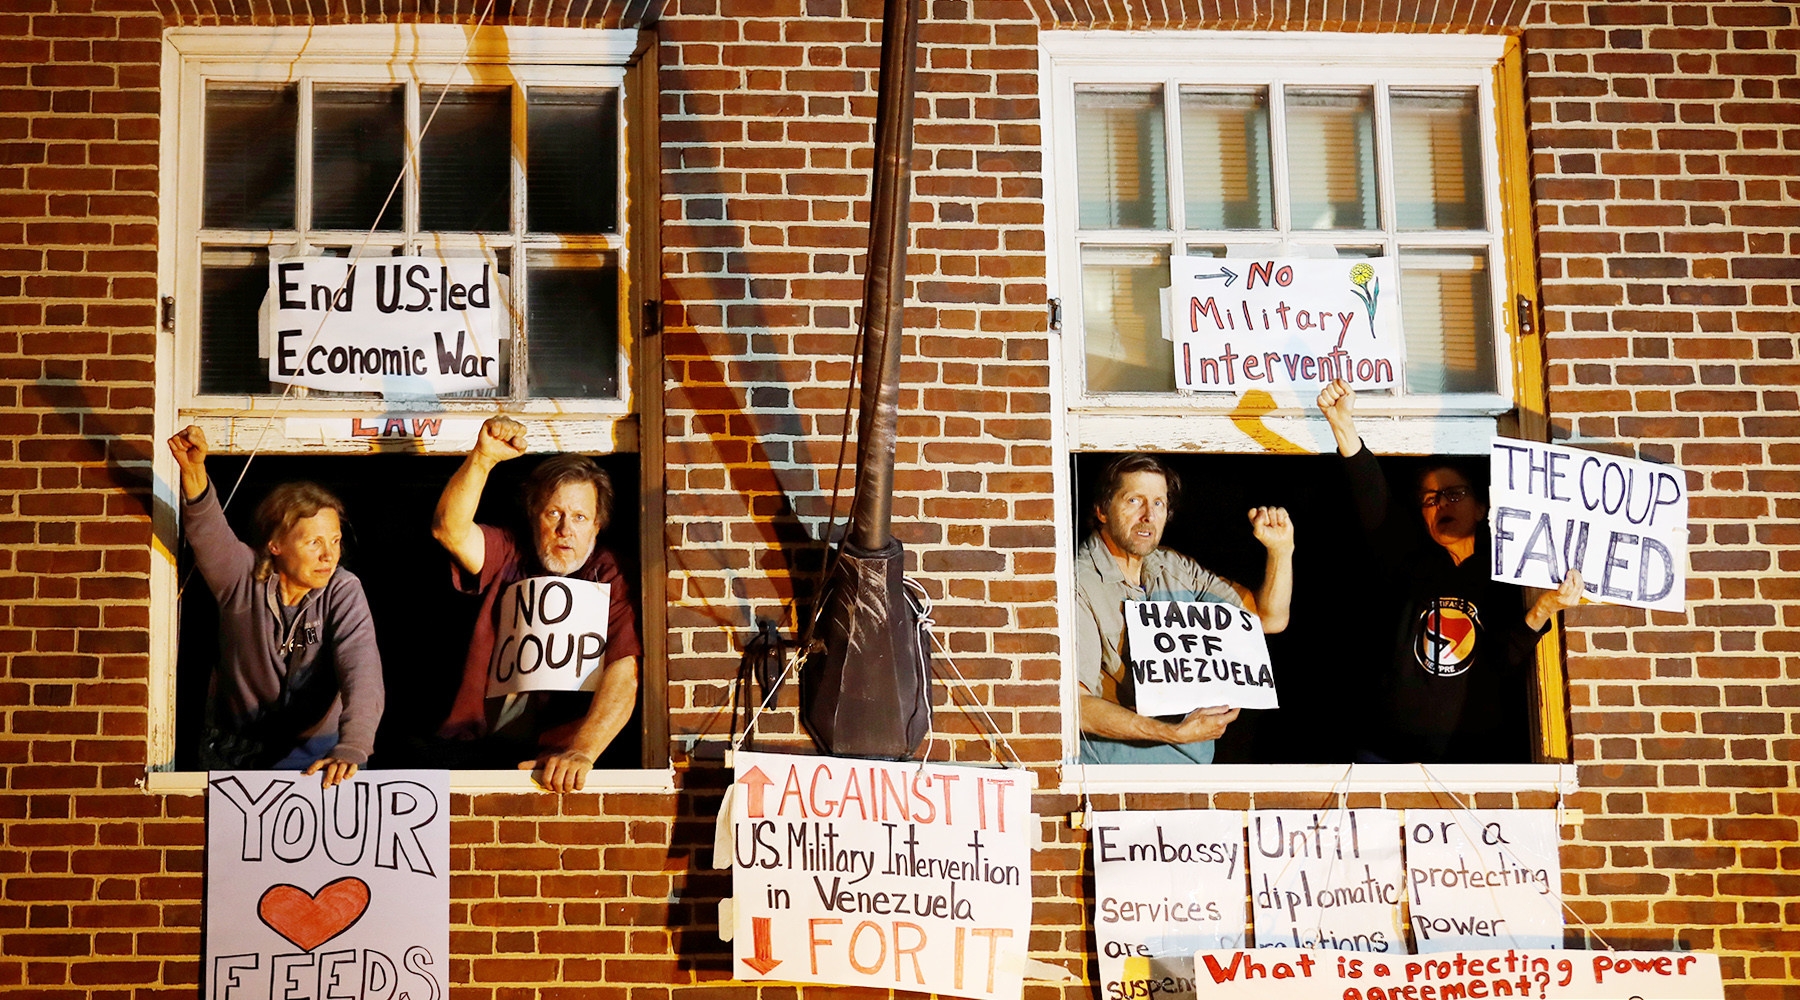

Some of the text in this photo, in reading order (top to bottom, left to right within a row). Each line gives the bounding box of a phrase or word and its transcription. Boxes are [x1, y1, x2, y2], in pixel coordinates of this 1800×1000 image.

[278, 263, 354, 312] End
[1247, 260, 1294, 289] No
[1190, 296, 1354, 348] Military
[278, 329, 495, 378] Economic War
[1183, 341, 1394, 385] Intervention
[1493, 443, 1681, 526] THE COUP
[1494, 506, 1675, 603] FAILED
[513, 579, 573, 629] NO
[1139, 601, 1253, 631] HANDS
[496, 632, 607, 683] COUP
[1153, 632, 1223, 656] OFF
[1131, 657, 1274, 688] VENEZUELA
[777, 763, 1015, 833] AGAINST IT
[209, 775, 437, 878] YOUR
[1256, 811, 1360, 860] Until
[1412, 821, 1511, 845] or a
[787, 821, 875, 885] Military
[881, 823, 1020, 886] Intervention
[1098, 825, 1238, 880] Embassy
[767, 875, 976, 921] in Venezuela
[1258, 864, 1399, 922] diplomatic
[1410, 852, 1550, 905] protecting
[214, 946, 440, 1000] FEEDS
[808, 918, 1014, 994] FOR IT
[1105, 939, 1153, 959] are
[1202, 949, 1697, 987] What is a protecting power
